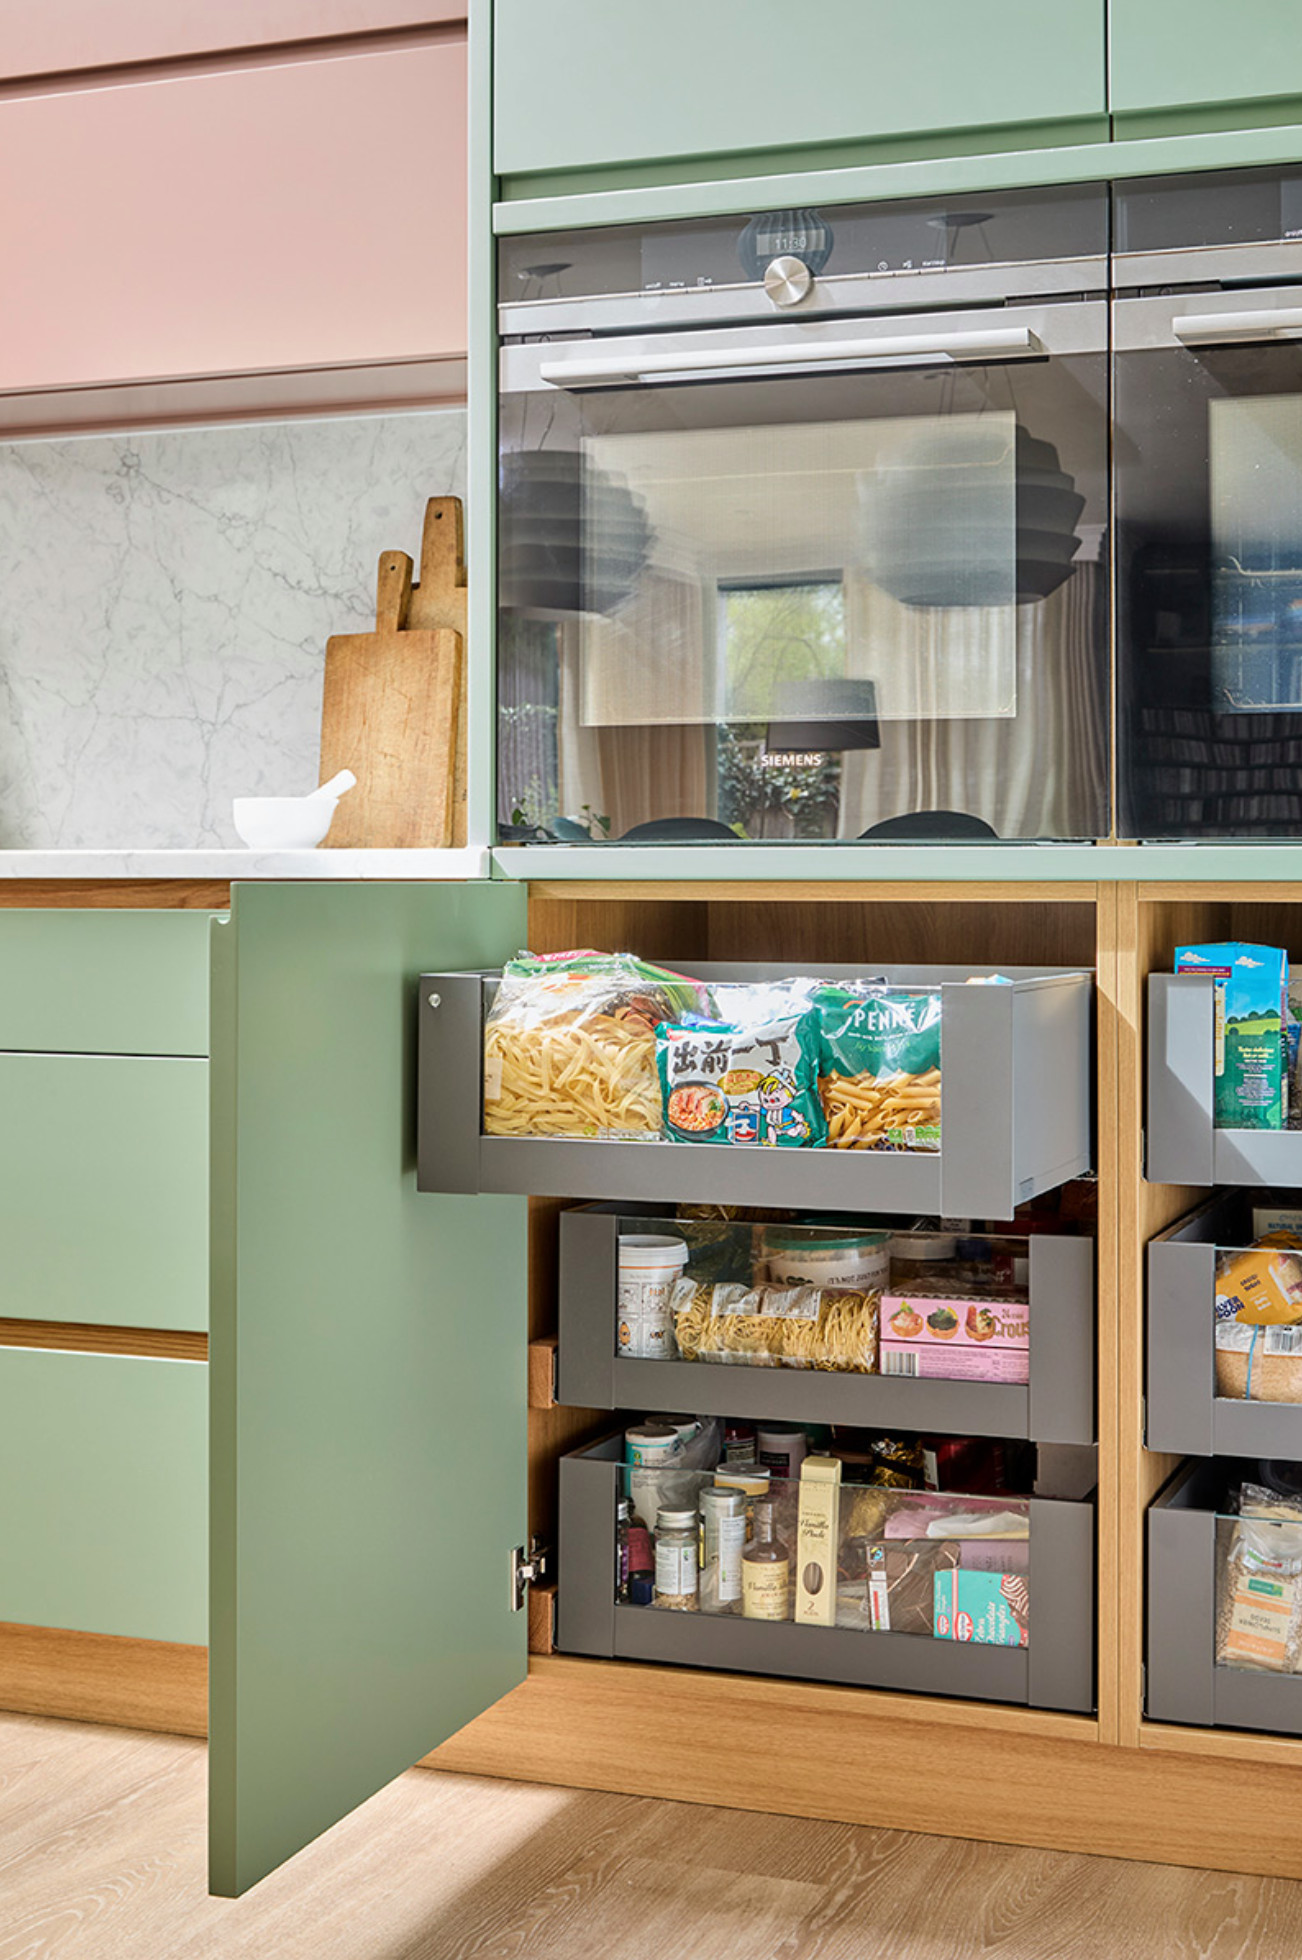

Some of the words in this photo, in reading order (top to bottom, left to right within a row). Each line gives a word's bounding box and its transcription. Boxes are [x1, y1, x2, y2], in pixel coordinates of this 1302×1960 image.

[761, 754, 821, 766] SIEMENS
[673, 1035, 789, 1073] 出前一丁
[1215, 1296, 1241, 1313] ILVER
[1217, 1301, 1245, 1319] POON
